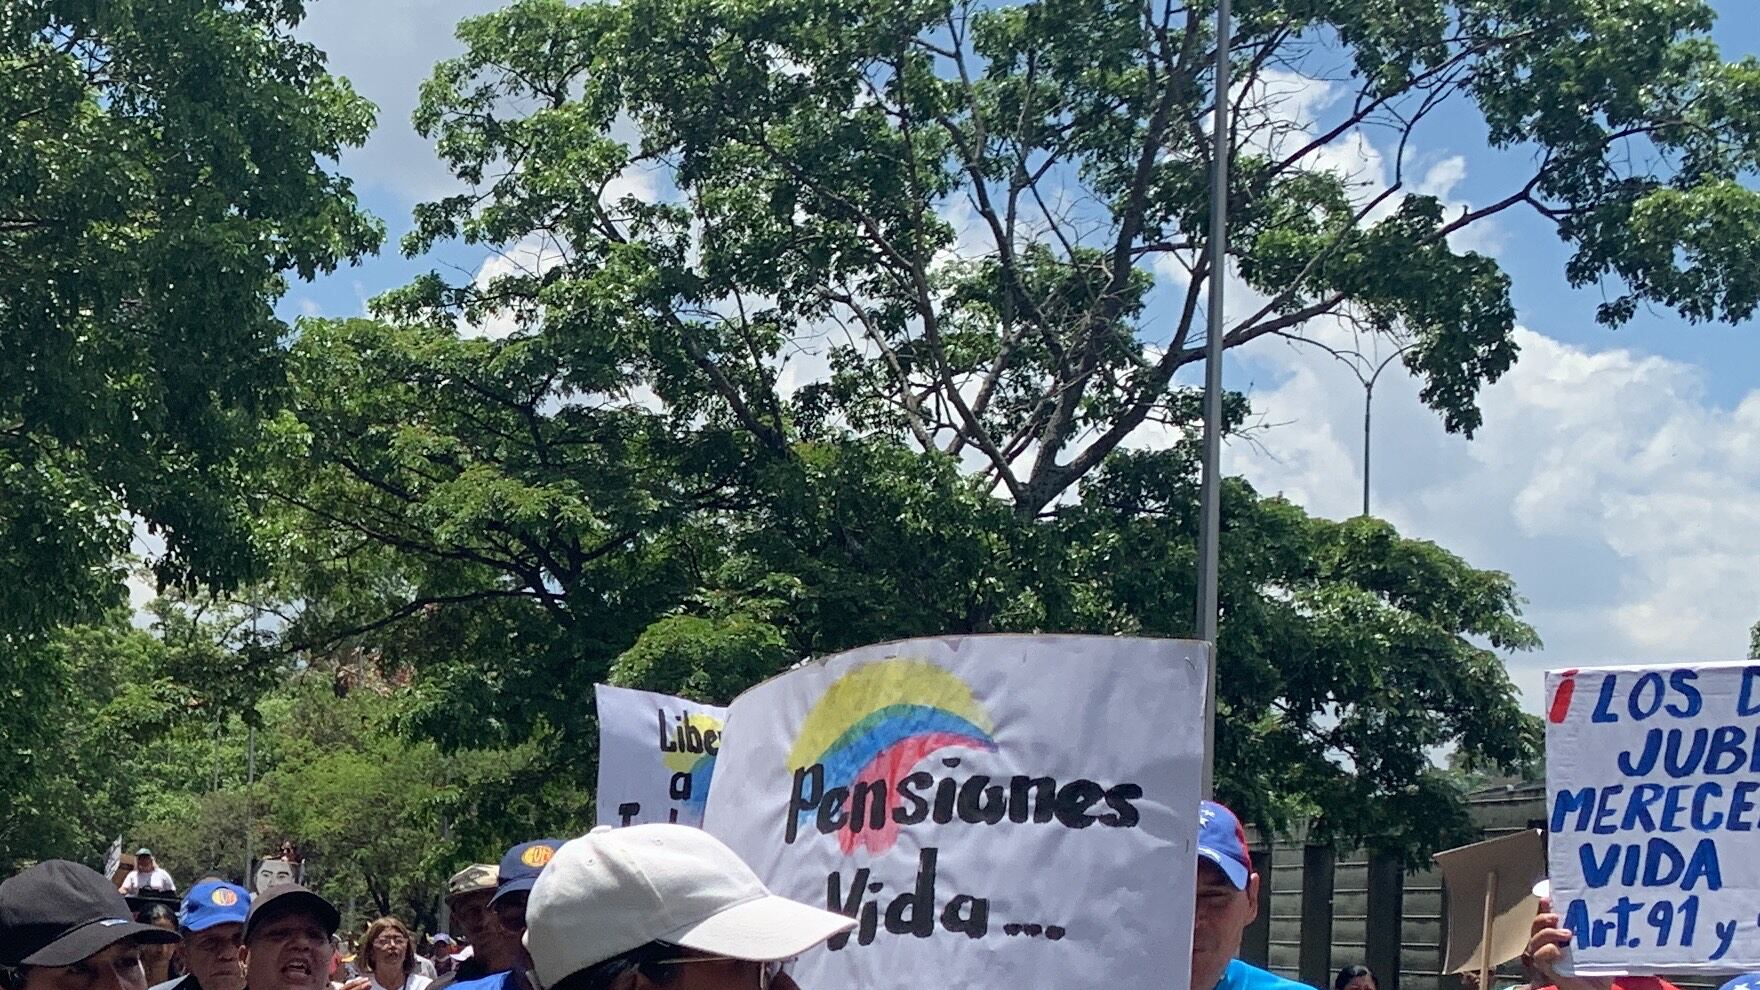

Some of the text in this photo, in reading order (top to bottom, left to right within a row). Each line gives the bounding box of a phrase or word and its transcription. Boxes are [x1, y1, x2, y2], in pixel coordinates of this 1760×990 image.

[1591, 668, 1703, 723] LOS
[669, 771, 693, 801] a
[784, 757, 1144, 844] Pensiones
[1578, 837, 1723, 892] VIDA
[1709, 919, 1737, 961] y
